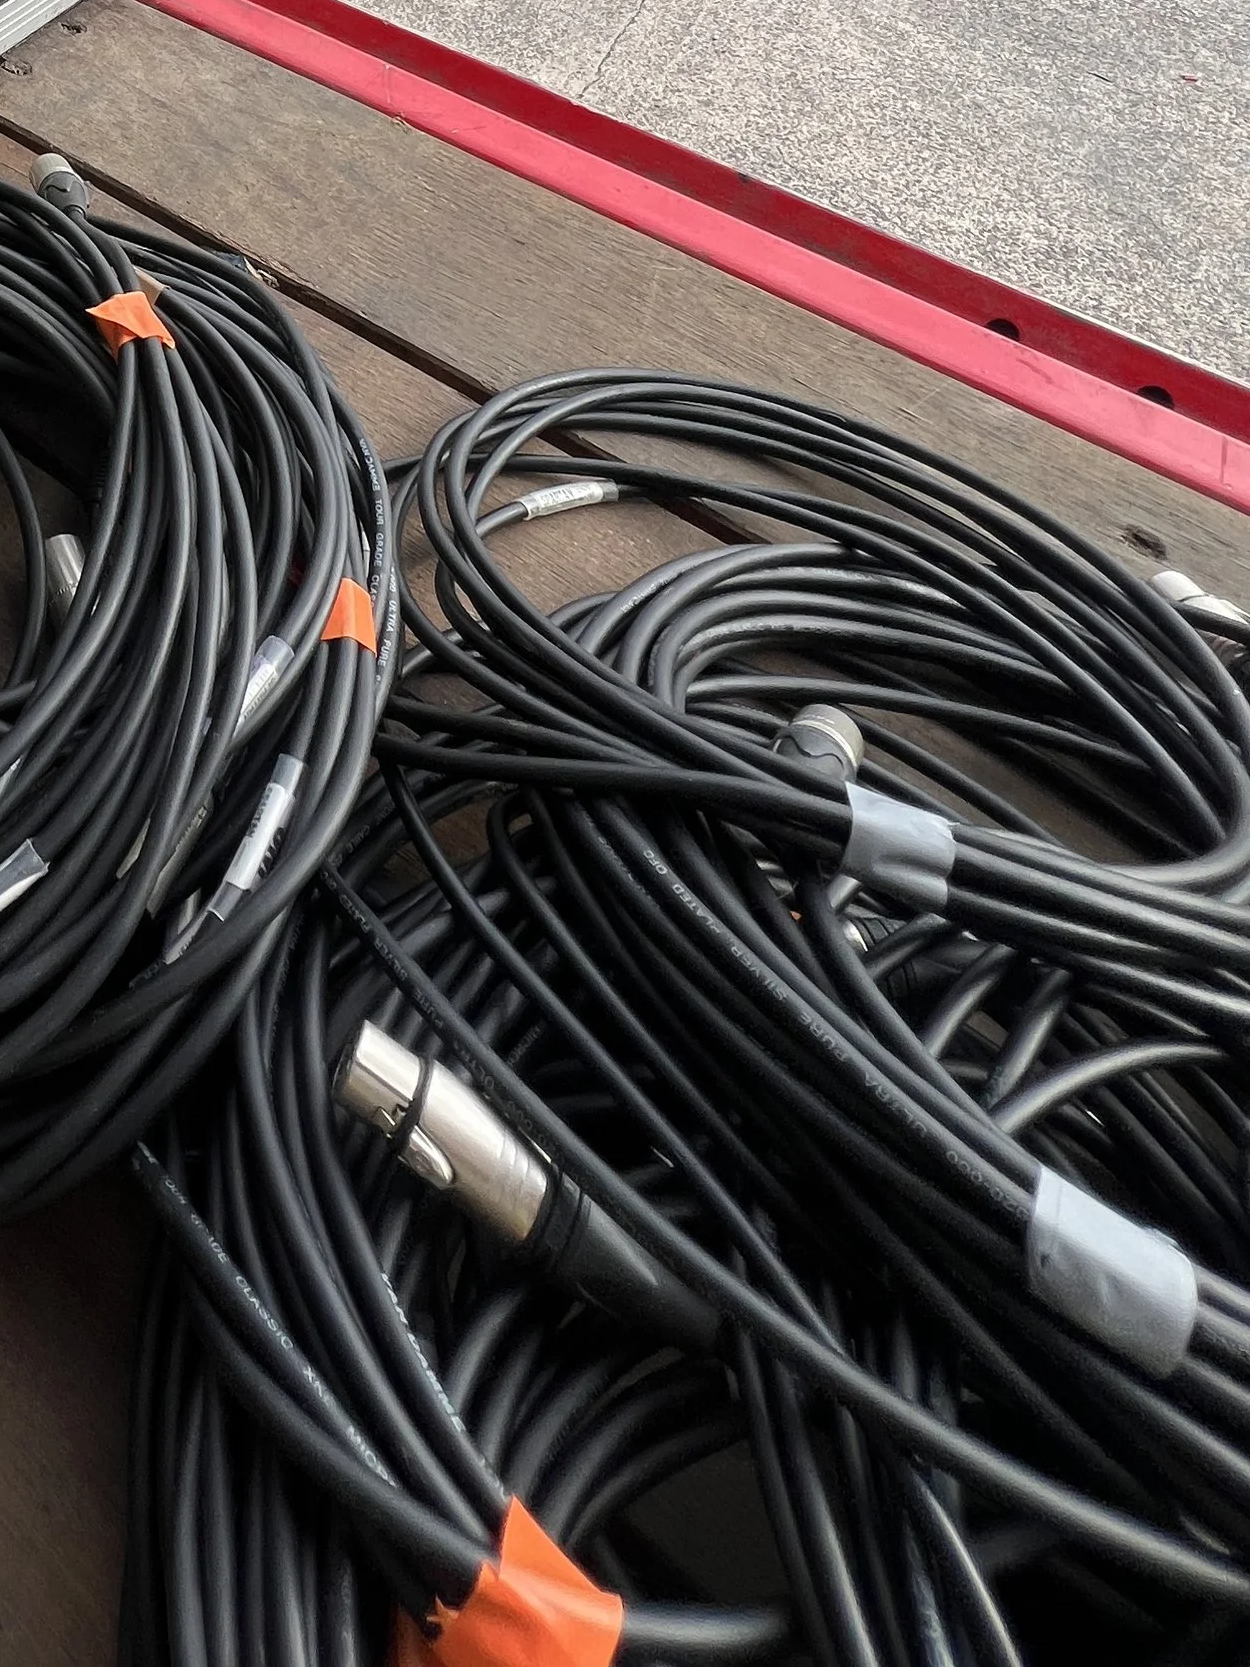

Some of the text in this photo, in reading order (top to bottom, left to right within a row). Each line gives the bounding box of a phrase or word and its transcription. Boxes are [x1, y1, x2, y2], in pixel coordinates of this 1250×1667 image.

[373, 498, 384, 525] TOUR
[374, 532, 383, 565] GRADE
[385, 600, 396, 632] ULTRA
[376, 638, 392, 667] PURE
[641, 848, 669, 876] OFC
[798, 1011, 851, 1063] PURE
[233, 1273, 294, 1350] CLASSIC
